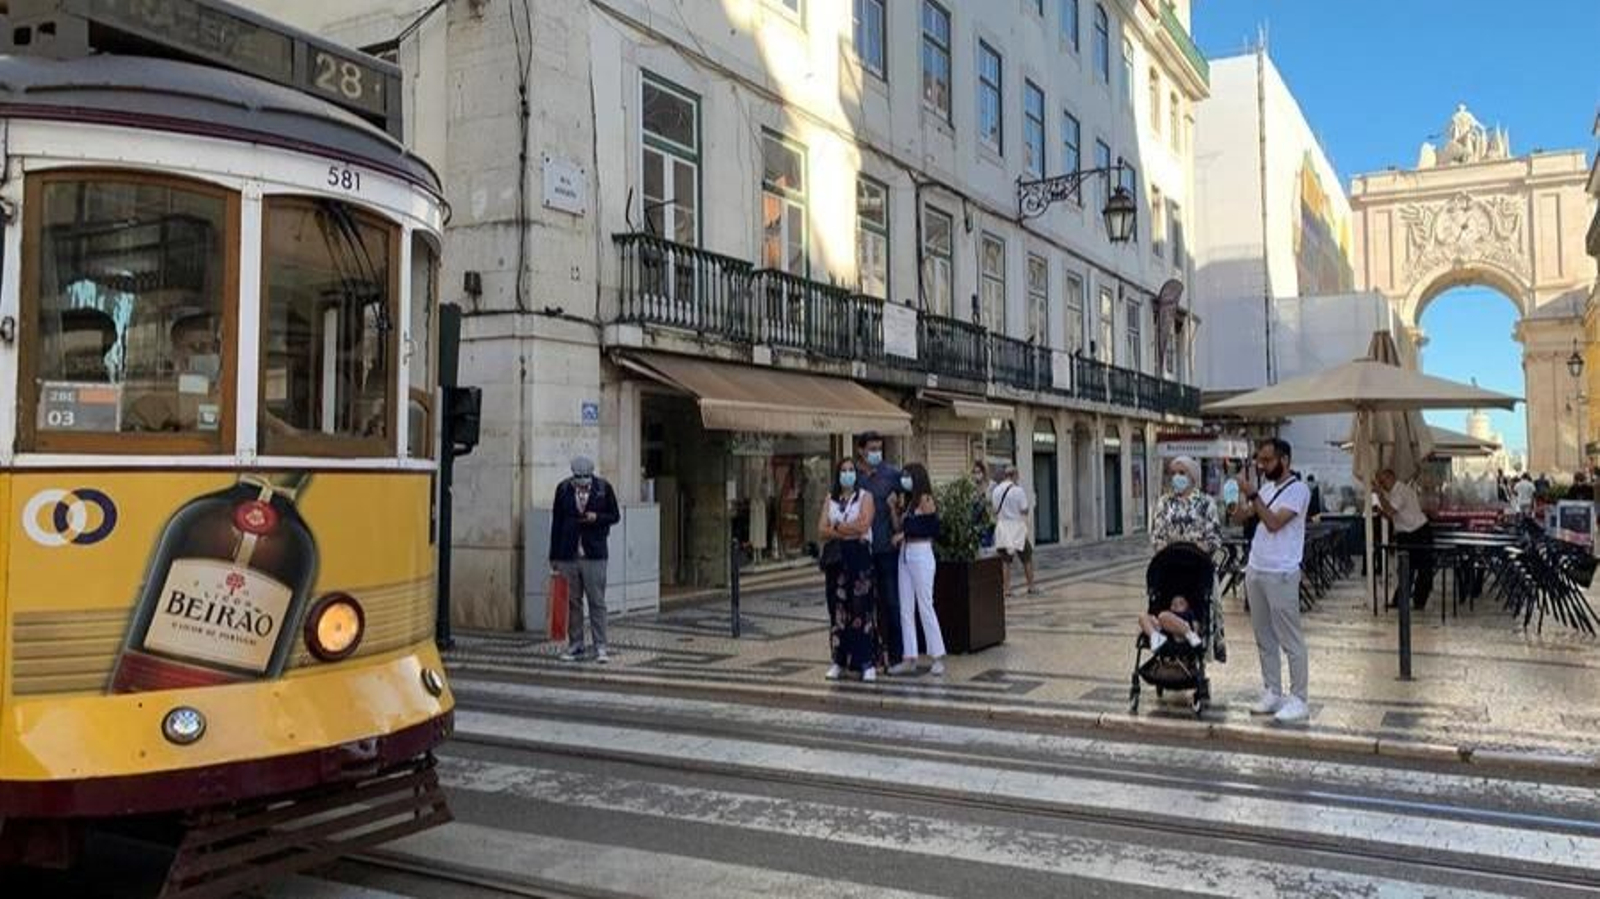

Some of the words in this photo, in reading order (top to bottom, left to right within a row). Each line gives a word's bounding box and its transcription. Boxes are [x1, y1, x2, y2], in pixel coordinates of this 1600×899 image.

[315, 52, 363, 100] 28
[327, 167, 361, 192] 581
[48, 410, 75, 426] 03
[165, 589, 274, 638] BEIRÃO
